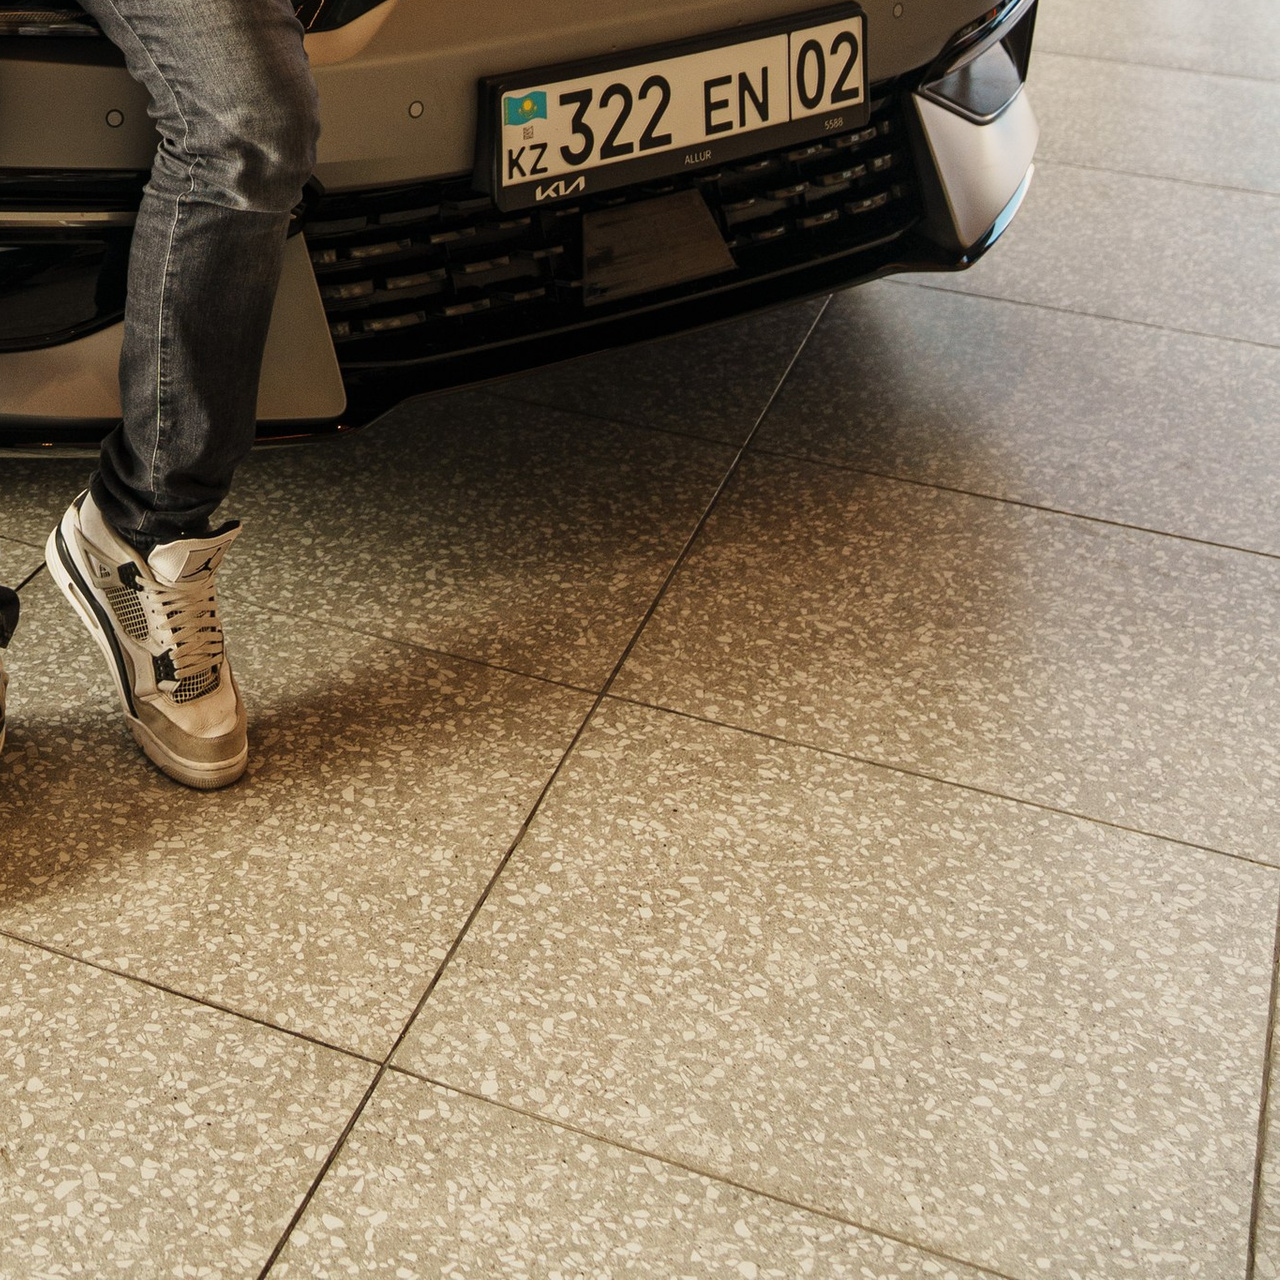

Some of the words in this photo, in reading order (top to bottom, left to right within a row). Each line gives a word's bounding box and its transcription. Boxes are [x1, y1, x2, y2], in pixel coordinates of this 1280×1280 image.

[558, 74, 673, 167] 322
[704, 65, 770, 136] EN
[795, 30, 860, 110] 02
[507, 142, 549, 180] KZ
[684, 150, 712, 166] ALLUR
[535, 175, 586, 201] KIA
